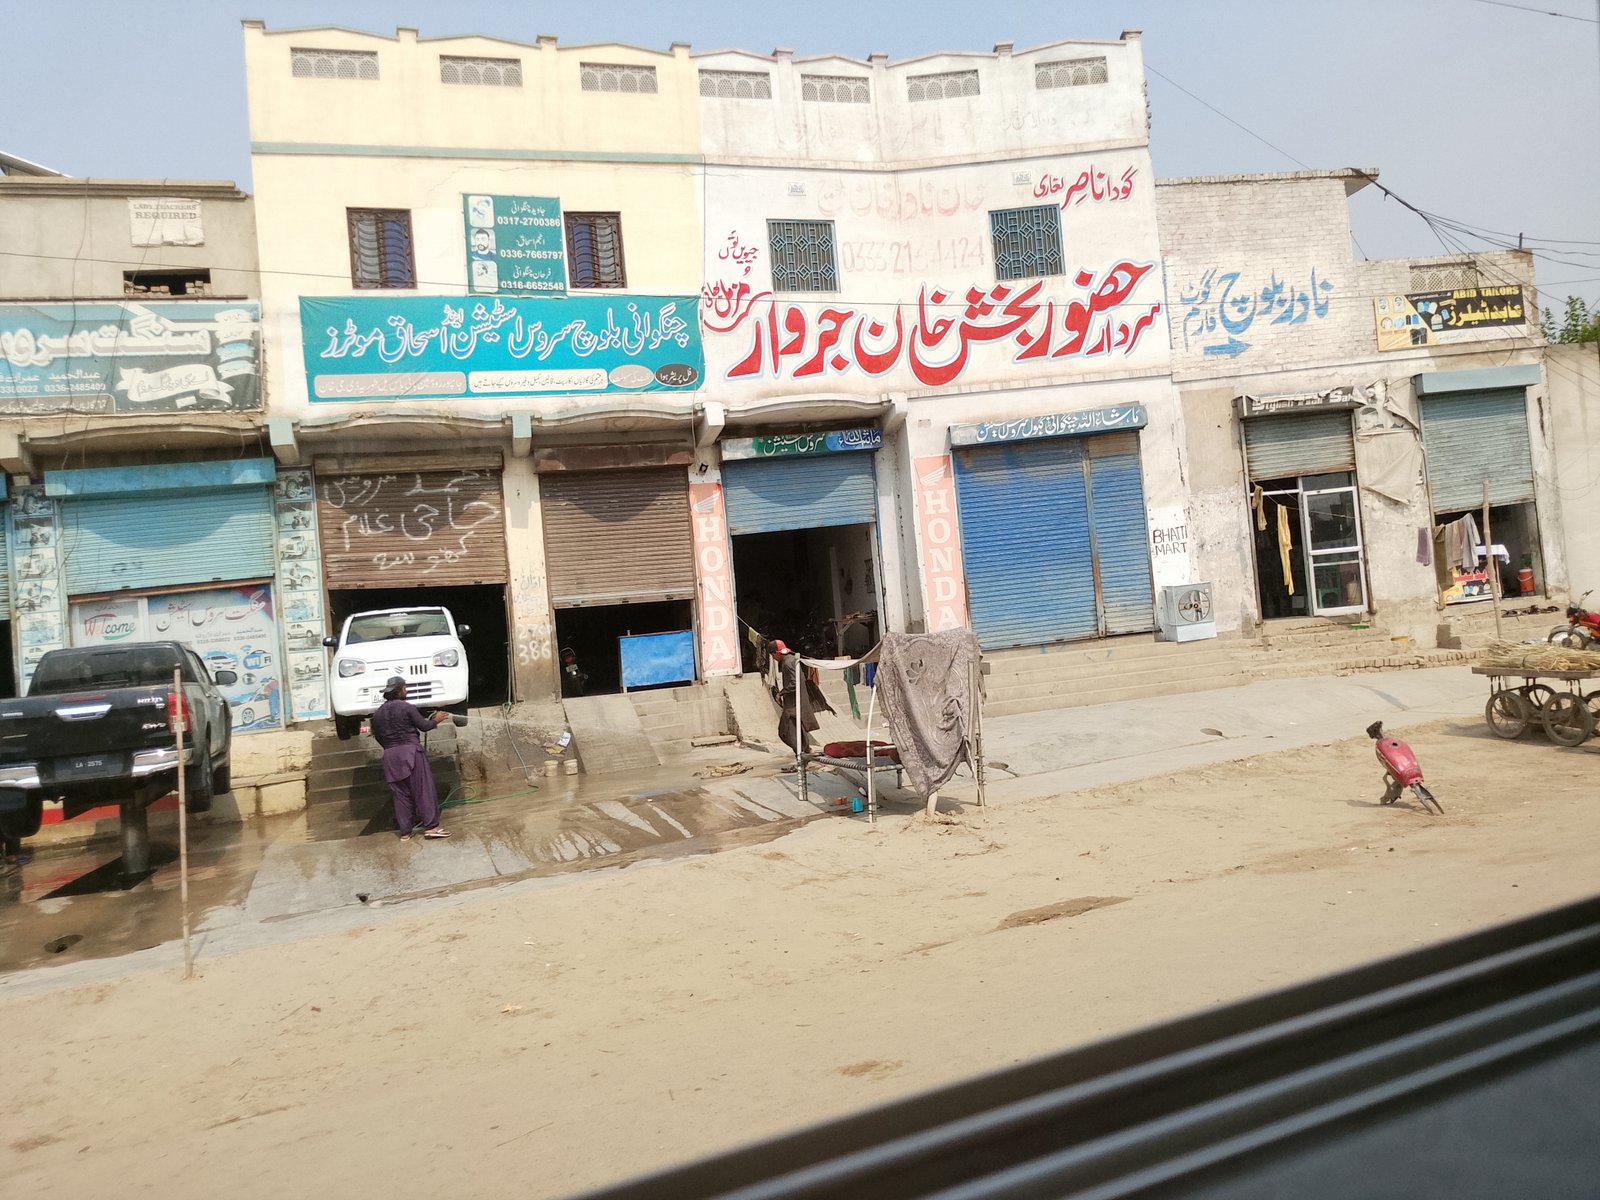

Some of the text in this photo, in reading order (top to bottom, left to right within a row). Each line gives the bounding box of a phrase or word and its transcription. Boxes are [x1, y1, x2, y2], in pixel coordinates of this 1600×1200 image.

[1033, 174, 1065, 199] لغاری
[134, 211, 197, 220] REQUIRED
[497, 216, 561, 227] 0317-2700386
[500, 249, 564, 260] 0336-7665797
[1016, 261, 1154, 361] حضور
[1217, 265, 1335, 336] نادر بلوچ
[319, 317, 384, 359] موٹرز
[378, 314, 448, 364] اسحاق
[507, 319, 572, 362] سروس
[570, 307, 622, 357] بلوچ
[622, 301, 691, 357] چنگوانی
[908, 279, 1044, 387] بخش
[1086, 301, 1161, 356] سردار
[797, 432, 826, 453] سروس
[343, 507, 396, 553] غلام
[1153, 525, 1188, 544] BHATTI
[1154, 541, 1188, 556] MART
[922, 488, 964, 630] HONDA
[696, 515, 732, 662] HONDA
[518, 640, 552, 666] 386
